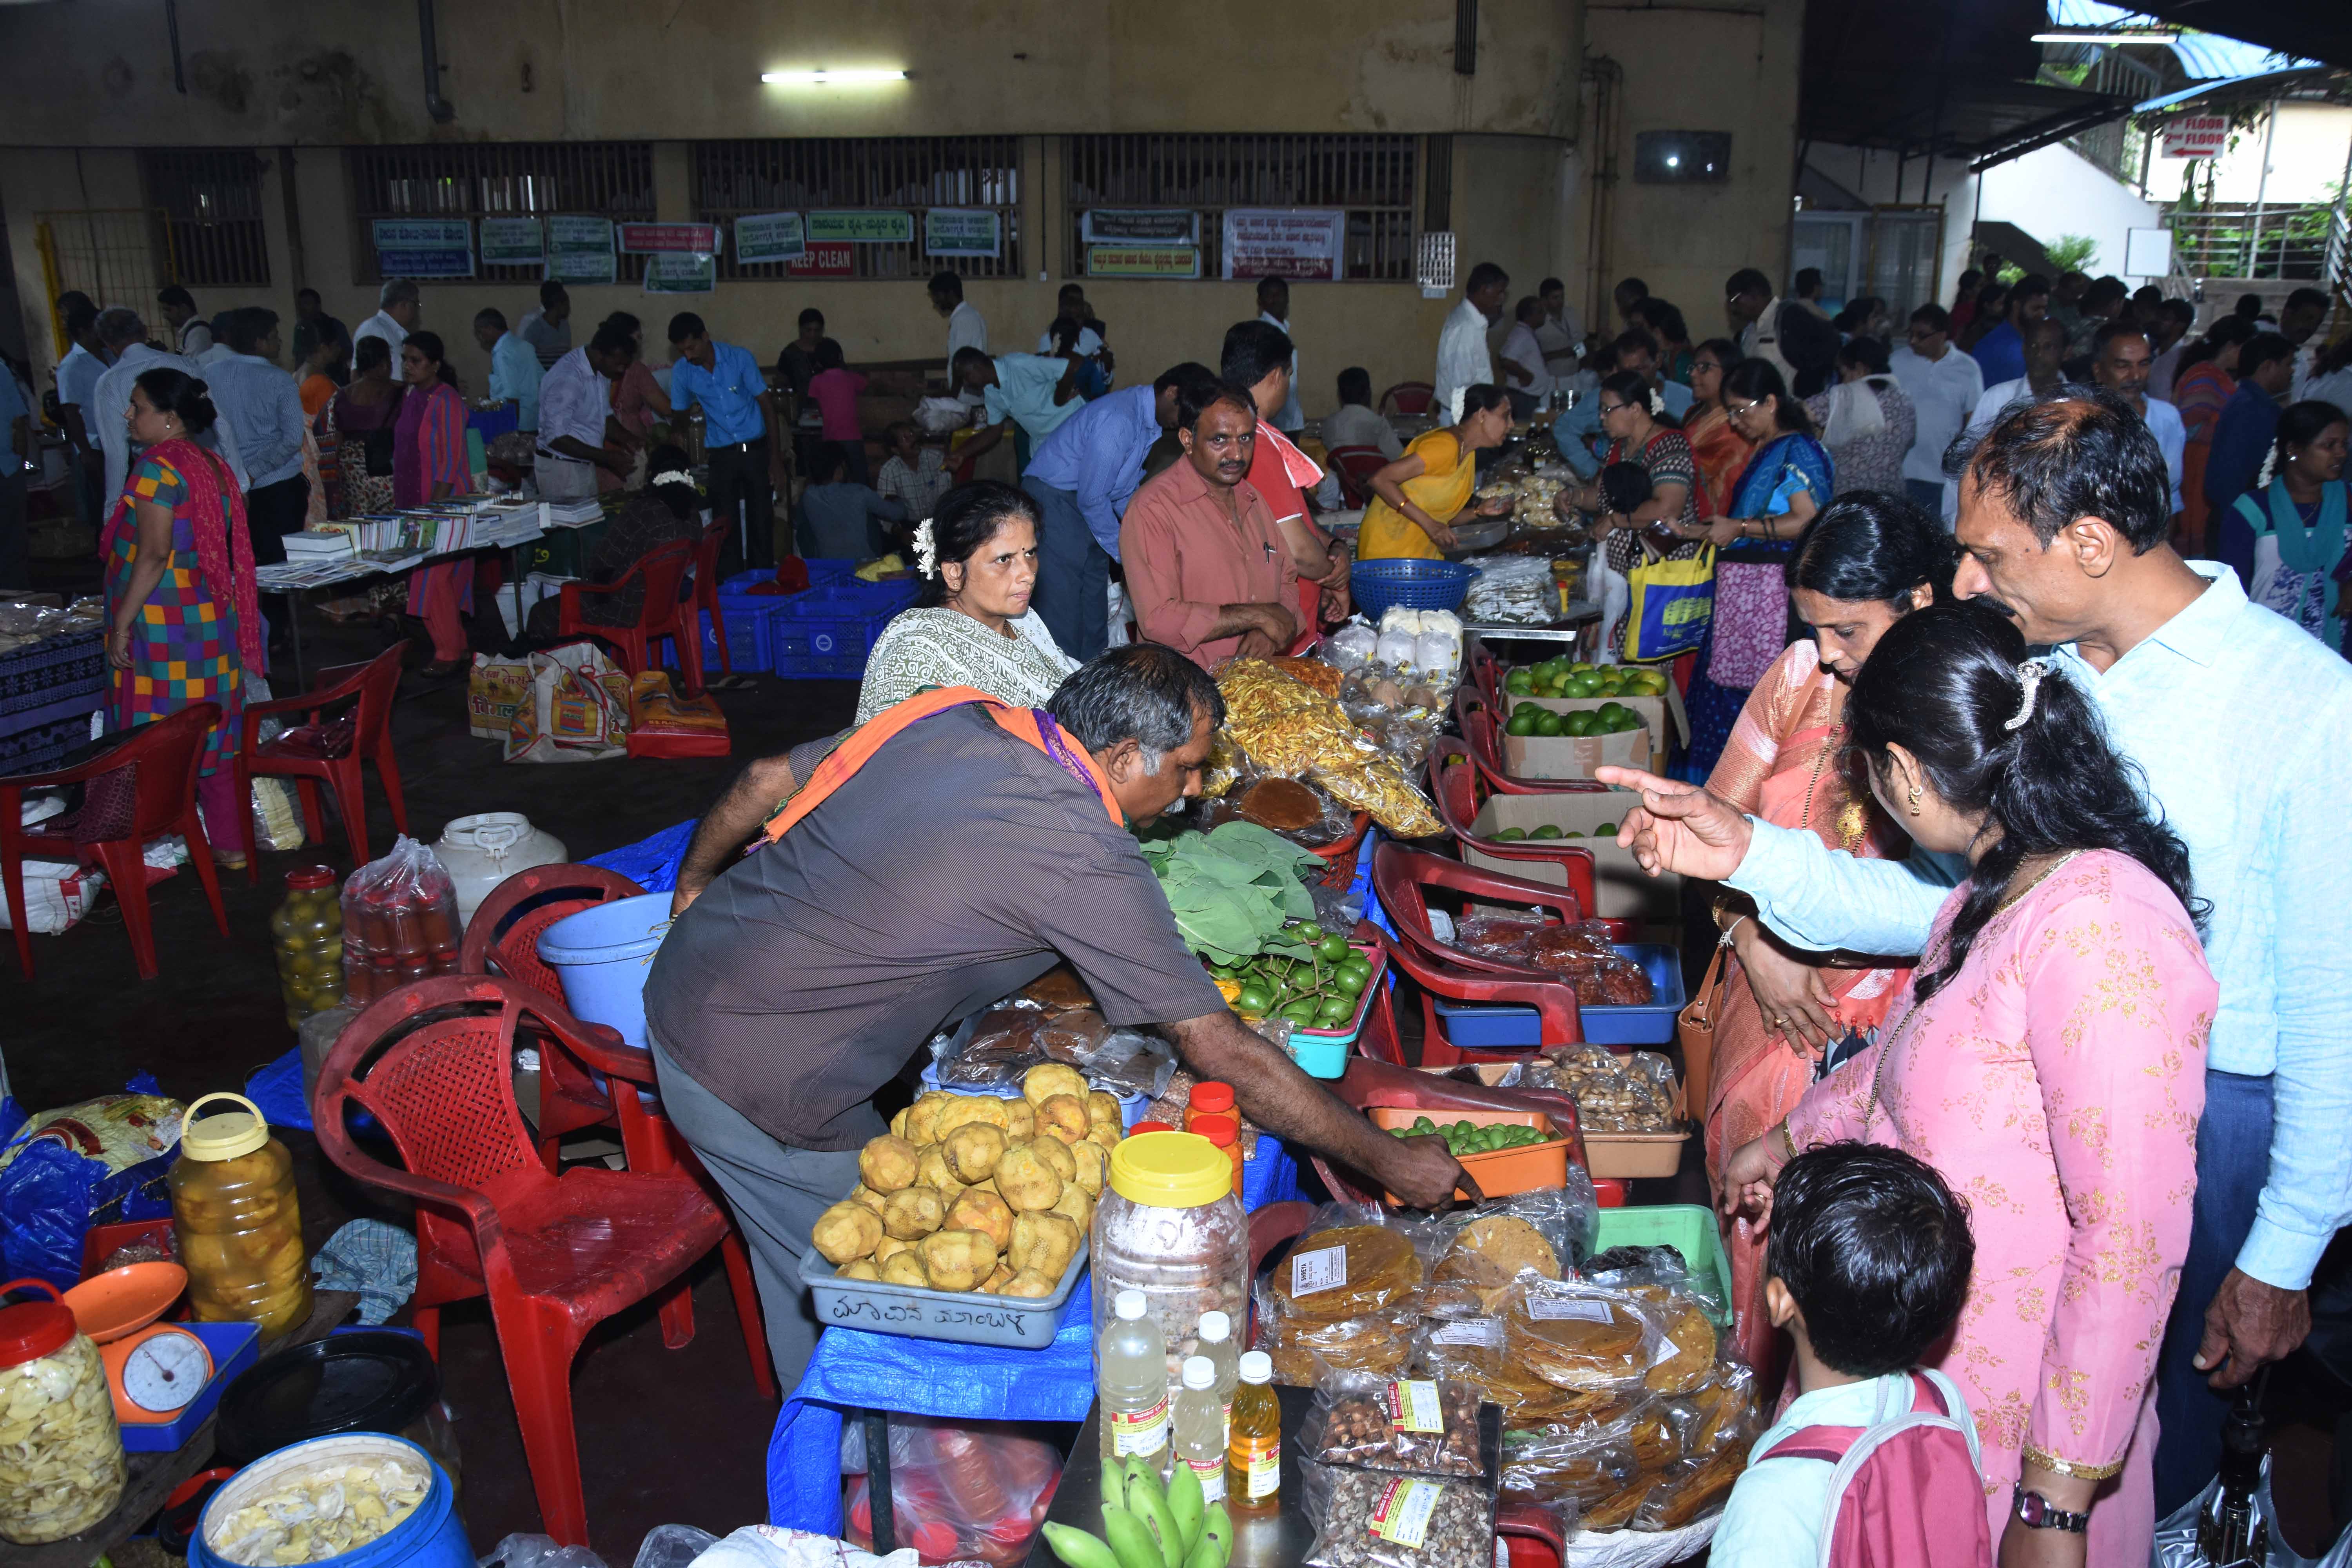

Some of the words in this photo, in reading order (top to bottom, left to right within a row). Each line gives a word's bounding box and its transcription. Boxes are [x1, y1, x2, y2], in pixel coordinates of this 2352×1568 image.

[2185, 118, 2223, 129] FLOOR
[2185, 133, 2223, 144] FLOOR
[792, 251, 816, 268] KEEP
[818, 250, 850, 268] CLEAN
